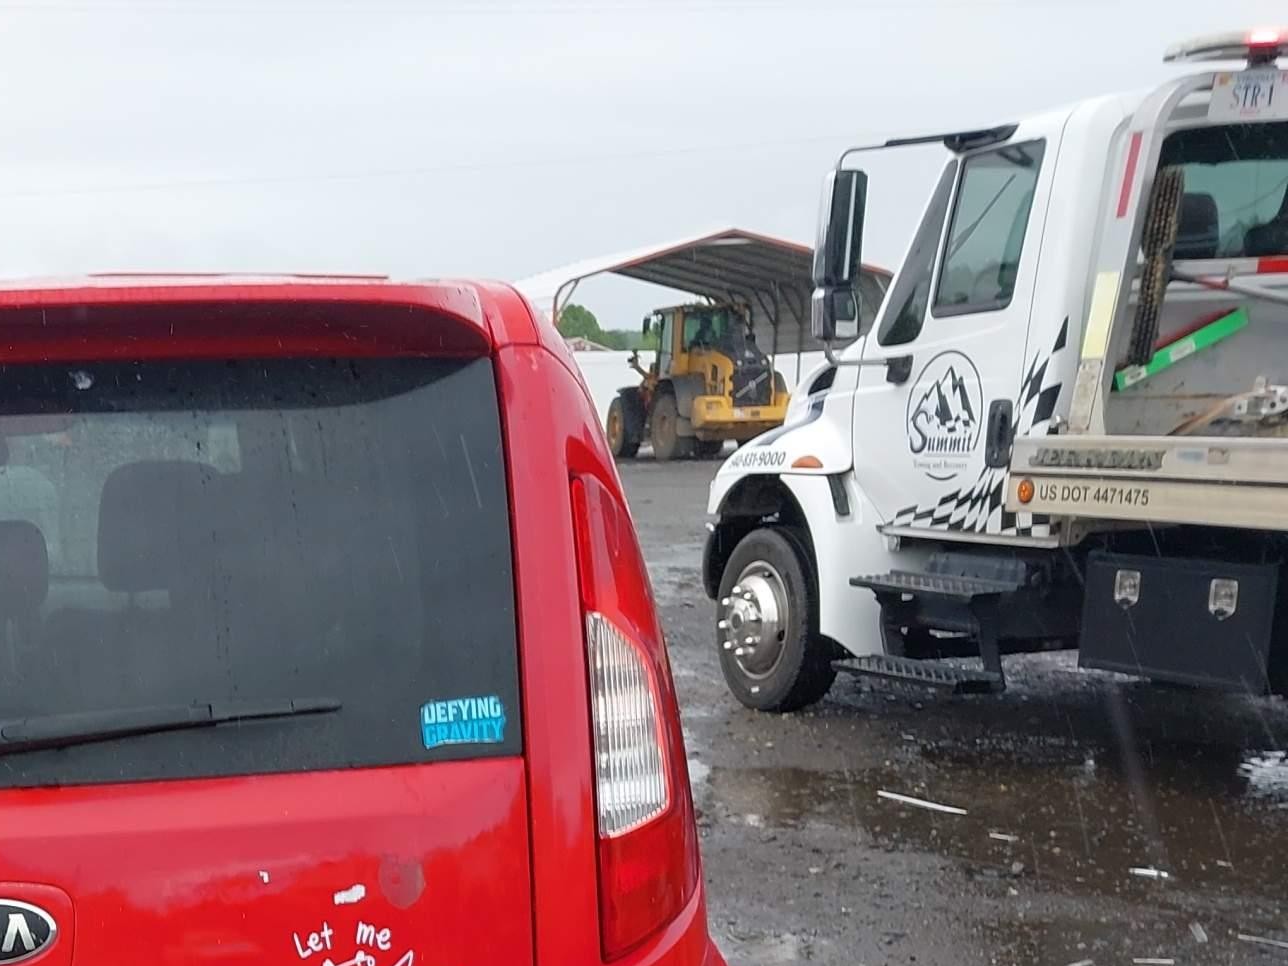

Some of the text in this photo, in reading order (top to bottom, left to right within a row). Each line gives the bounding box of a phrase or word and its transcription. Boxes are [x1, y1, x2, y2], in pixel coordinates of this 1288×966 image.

[909, 409, 972, 454] Summit
[1040, 484, 1150, 506] US DOT 4471475
[423, 696, 501, 724] DEFYING
[424, 719, 503, 746] GRAVITY
[293, 920, 392, 959] Let me
